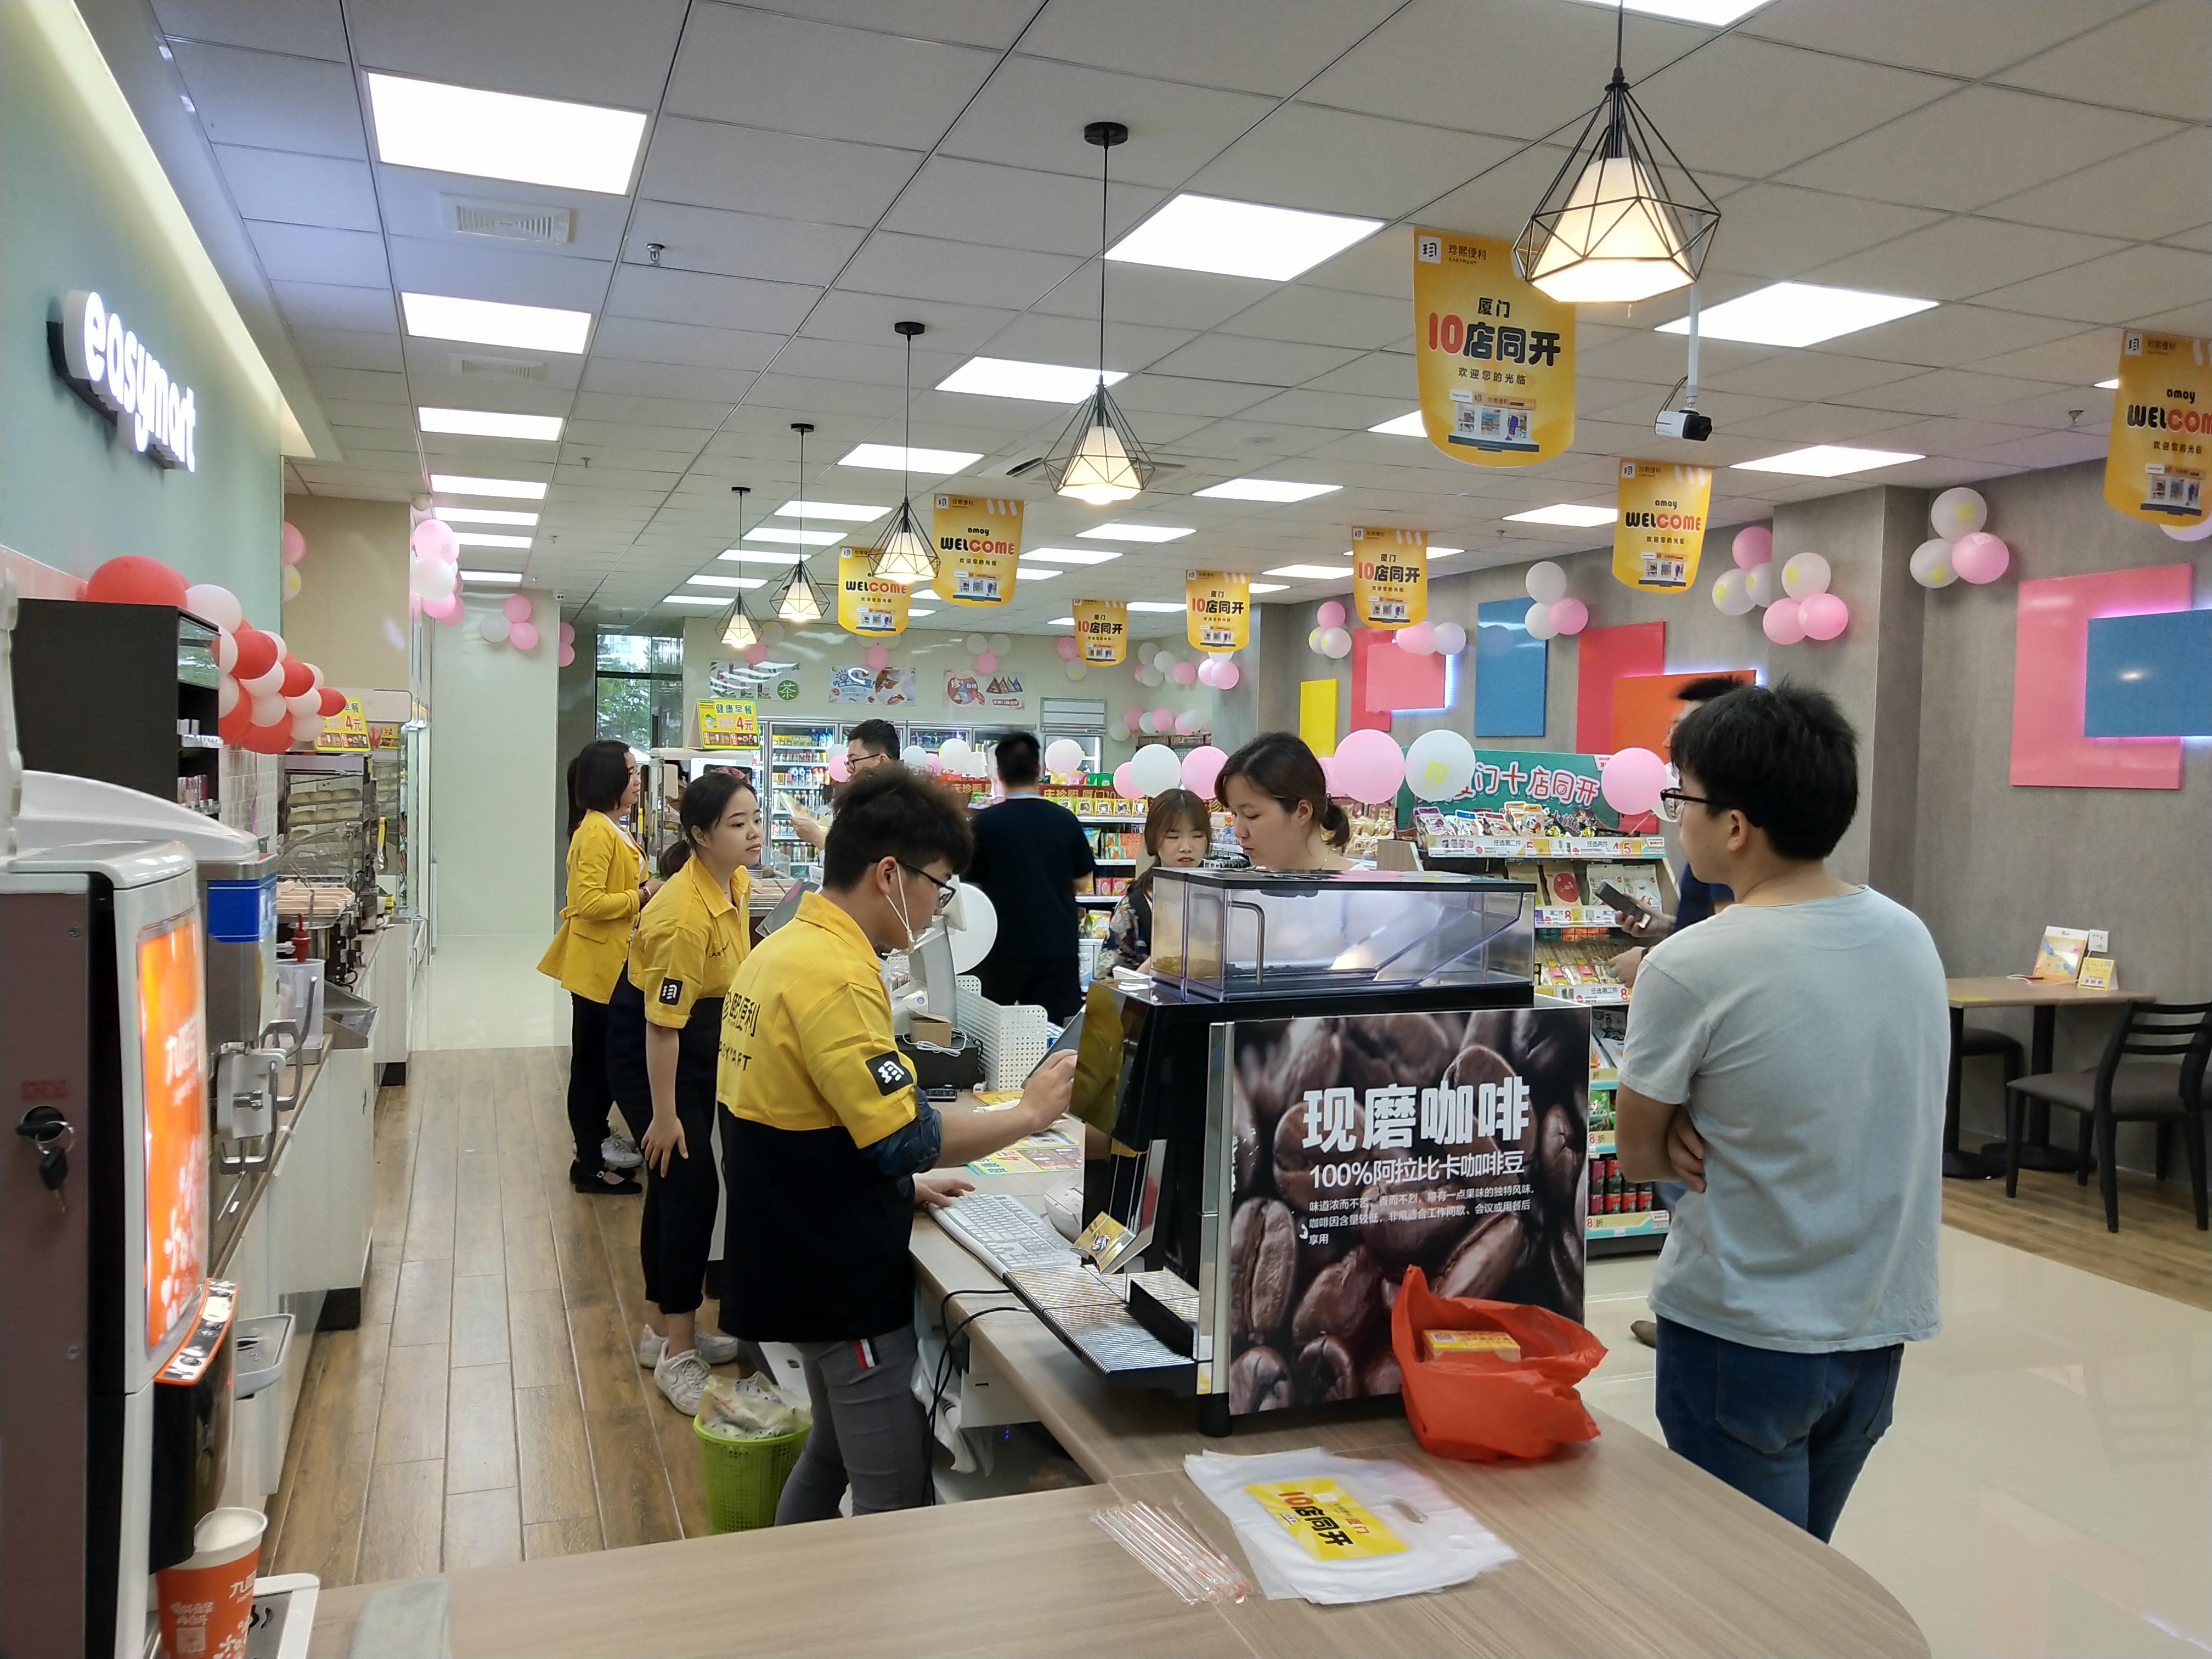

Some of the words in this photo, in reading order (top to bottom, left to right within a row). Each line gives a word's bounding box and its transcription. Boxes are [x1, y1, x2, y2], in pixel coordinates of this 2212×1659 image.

[1448, 244, 1487, 261] 珍熙便利
[1478, 297, 1510, 318] 厦门
[1429, 312, 1561, 366] 10店同开
[84, 291, 196, 472] easymart
[1458, 367, 1527, 385] 欢迎您的光临
[2166, 388, 2196, 404] amoy
[1655, 500, 1678, 509] amoy
[1626, 511, 1702, 531] WELCOME
[967, 527, 989, 537] amoy
[940, 537, 1014, 555] WELCOME
[1380, 554, 1396, 562] 厦门
[1358, 562, 1420, 583] 10店同开
[845, 580, 907, 594] WELCOME
[1192, 597, 1244, 615] 10店同开
[1078, 620, 1123, 635] 10店同开
[778, 682, 797, 699] 茶
[715, 703, 753, 715] 健康早餐
[346, 715, 362, 731] 4元
[736, 716, 753, 731] 4元
[1454, 761, 1600, 806] 门十店同开
[1082, 789, 1123, 799] 厦门10
[1565, 910, 1572, 922] 8
[1621, 988, 1629, 1000] 8
[1302, 1076, 1531, 1154] 现磨咖啡
[1309, 1150, 1526, 1189] 100%阿拉比卡咖啡豆
[1308, 1233, 1329, 1246] 享用
[1278, 1491, 1354, 1546] 10店同开
